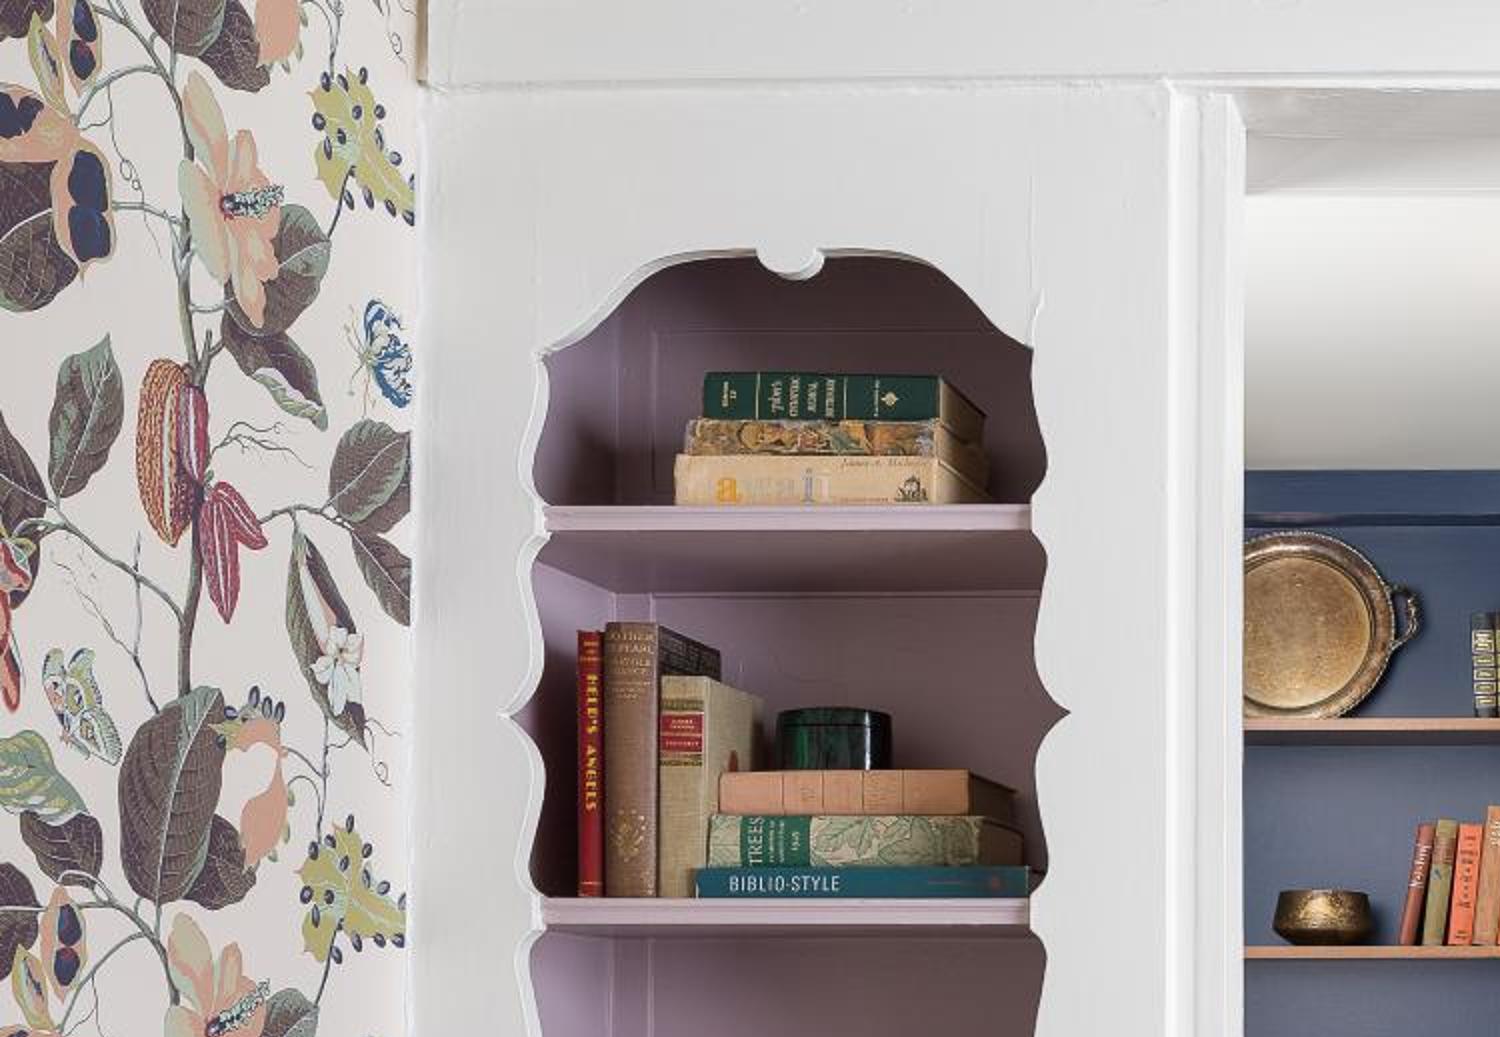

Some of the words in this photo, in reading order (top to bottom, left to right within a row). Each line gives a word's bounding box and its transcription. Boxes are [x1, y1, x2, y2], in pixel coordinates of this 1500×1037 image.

[583, 744, 599, 811] ANGELS
[747, 816, 765, 866] TREES
[729, 875, 841, 893] BIBLIO-STYLE
